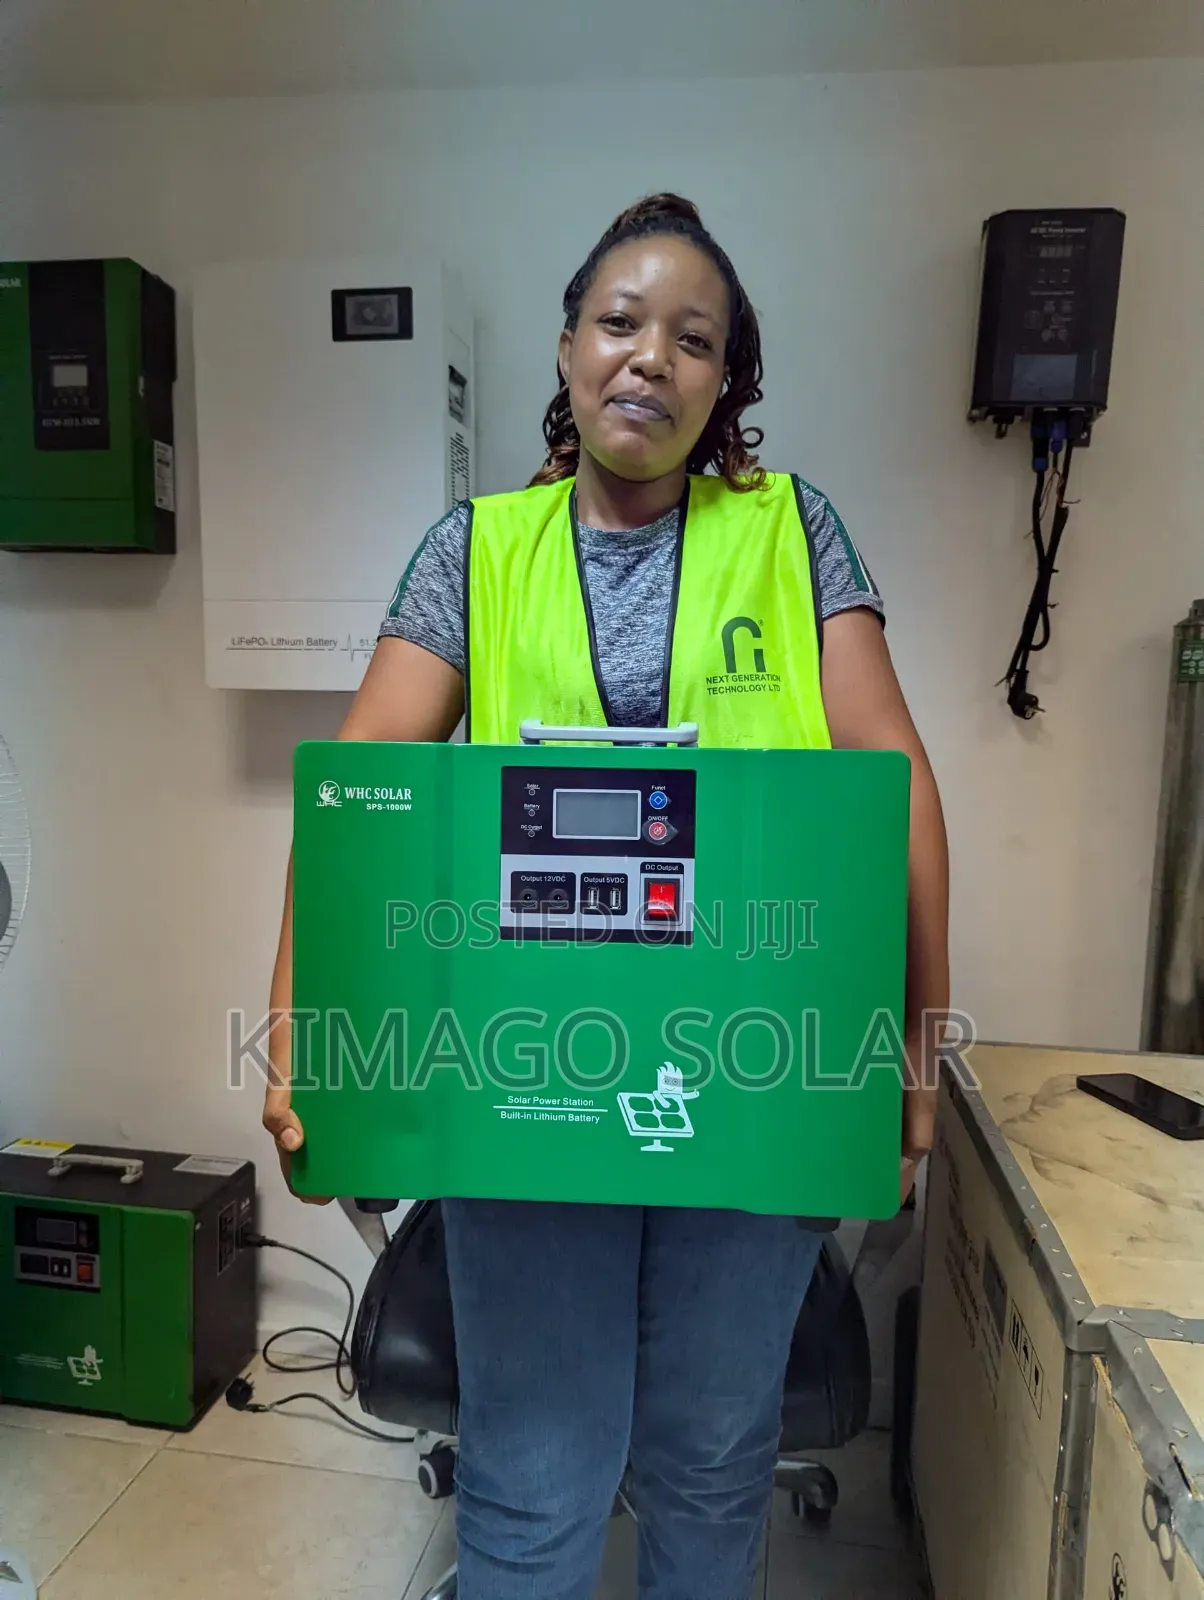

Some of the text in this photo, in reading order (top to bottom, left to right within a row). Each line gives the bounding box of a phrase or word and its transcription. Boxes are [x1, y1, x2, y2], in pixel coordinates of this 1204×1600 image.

[271, 637, 304, 646] Lithium
[306, 637, 338, 648] Battery
[706, 673, 781, 684] NEXT GENERATION
[707, 684, 780, 695] TECHNOLOGY LTD
[345, 787, 412, 800] WHC SOLAR
[366, 803, 412, 811] SPS-1000W
[657, 864, 679, 872] Output
[520, 875, 566, 883] Output 12VDC
[583, 876, 605, 884] Output
[508, 1096, 594, 1106] Solar Power Station
[500, 1111, 600, 1124] Built-in Lithium Battery
